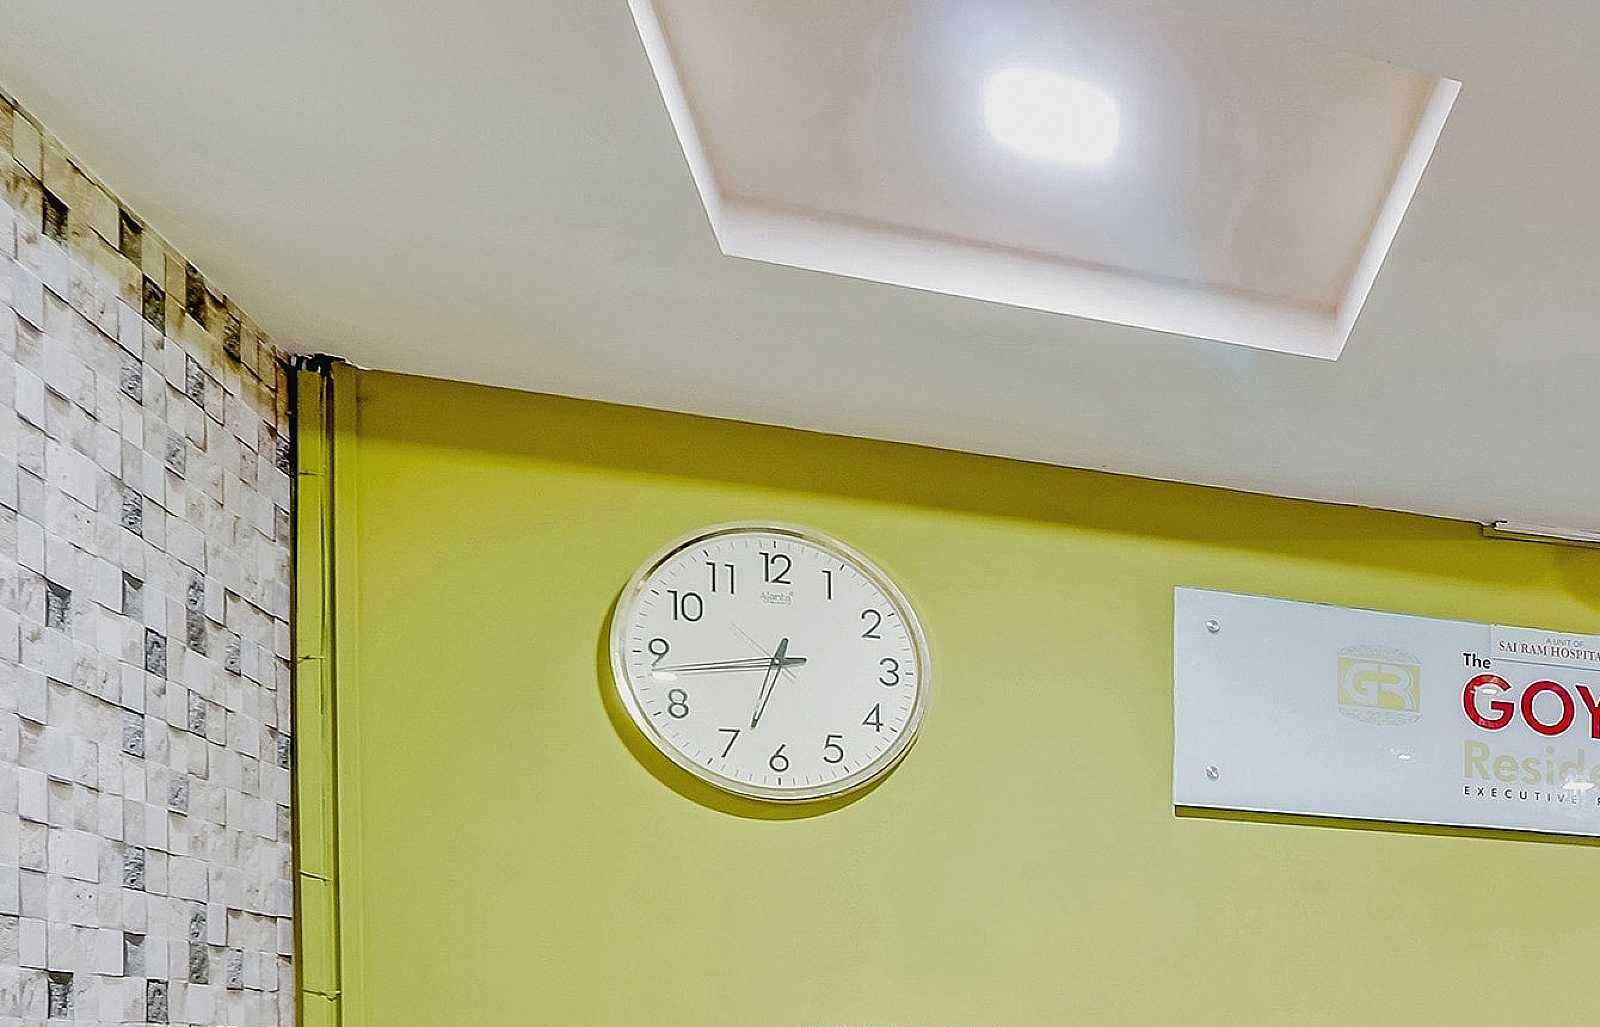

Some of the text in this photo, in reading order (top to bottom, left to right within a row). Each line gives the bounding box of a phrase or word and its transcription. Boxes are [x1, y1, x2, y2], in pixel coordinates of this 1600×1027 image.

[706, 562, 735, 594] 11
[759, 552, 792, 585] 12
[821, 570, 832, 600] 1
[667, 590, 703, 622] 10
[861, 609, 881, 639] 2
[648, 638, 670, 667] 9
[1463, 652, 1491, 669] The
[1499, 641, 1518, 653] SAI
[1521, 643, 1548, 656] RAM
[879, 658, 900, 686] 3
[668, 689, 689, 718] 8
[862, 703, 884, 732] 4
[718, 729, 740, 758] 7
[769, 744, 789, 772] 6
[823, 735, 844, 763] 5
